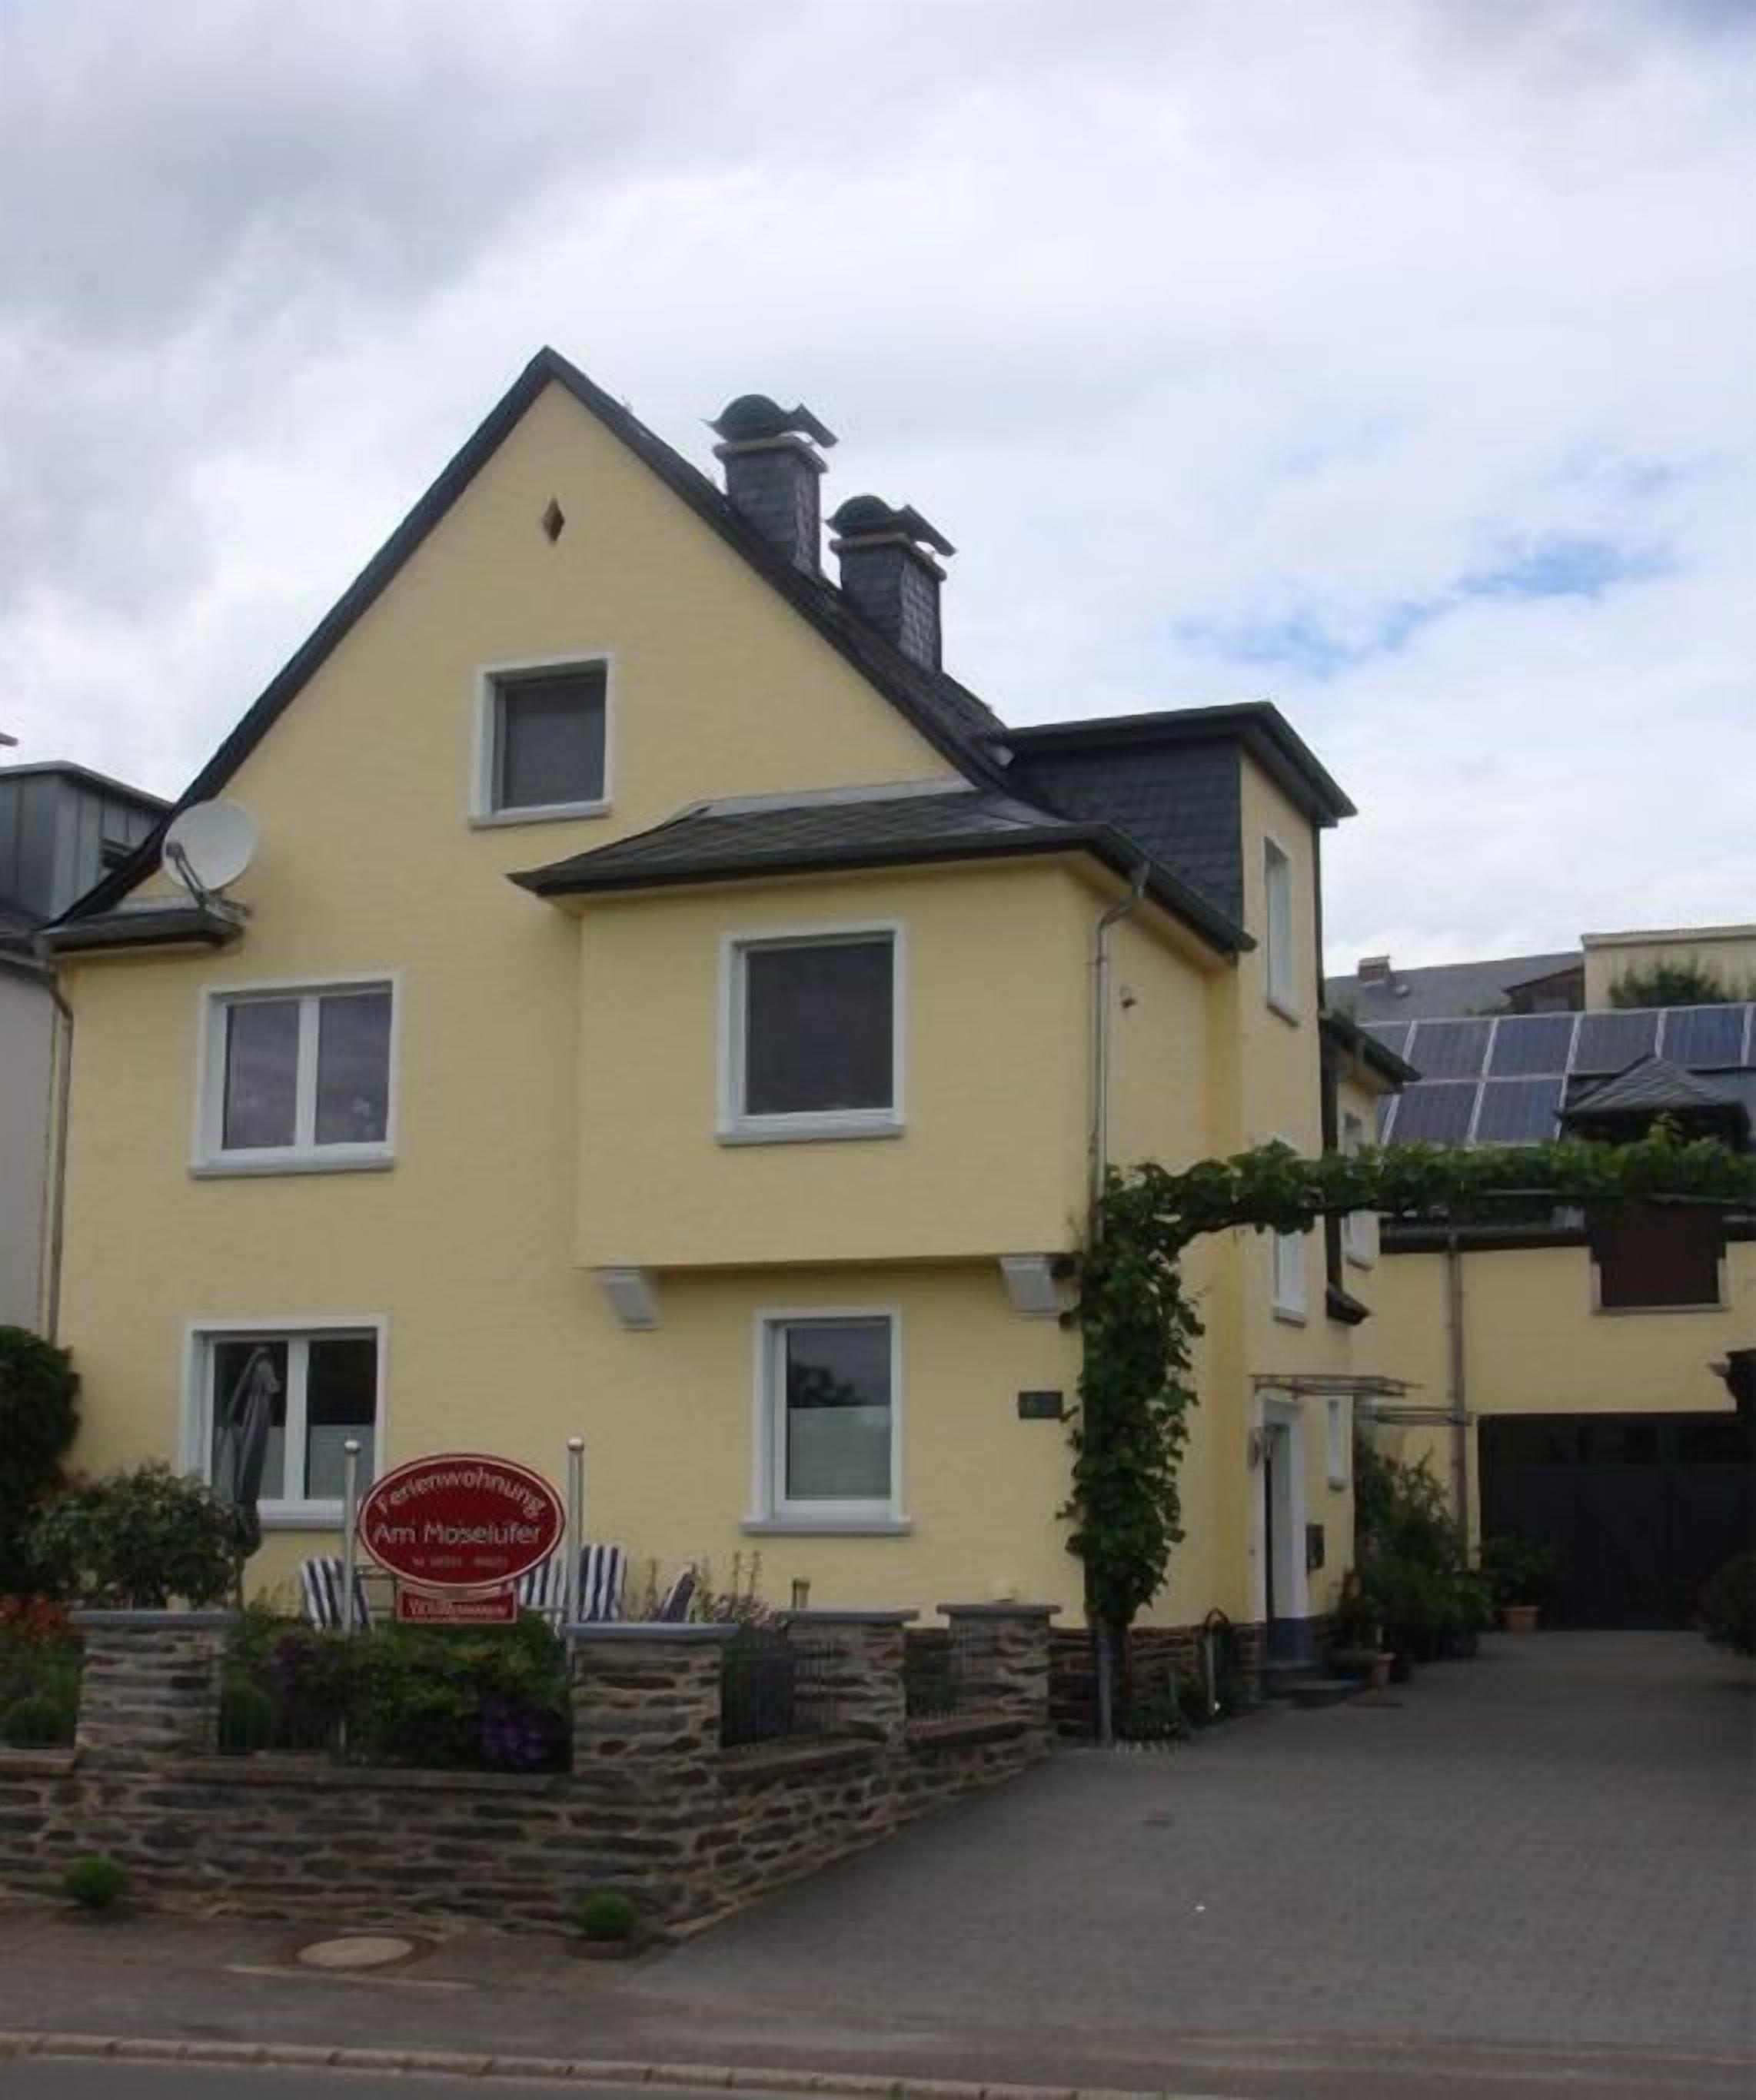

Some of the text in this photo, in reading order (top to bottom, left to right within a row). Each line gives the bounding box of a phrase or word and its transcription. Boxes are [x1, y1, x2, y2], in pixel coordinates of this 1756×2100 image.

[375, 1467, 547, 1519] Ferienwohnung
[375, 1521, 540, 1544] Am Moselufer
